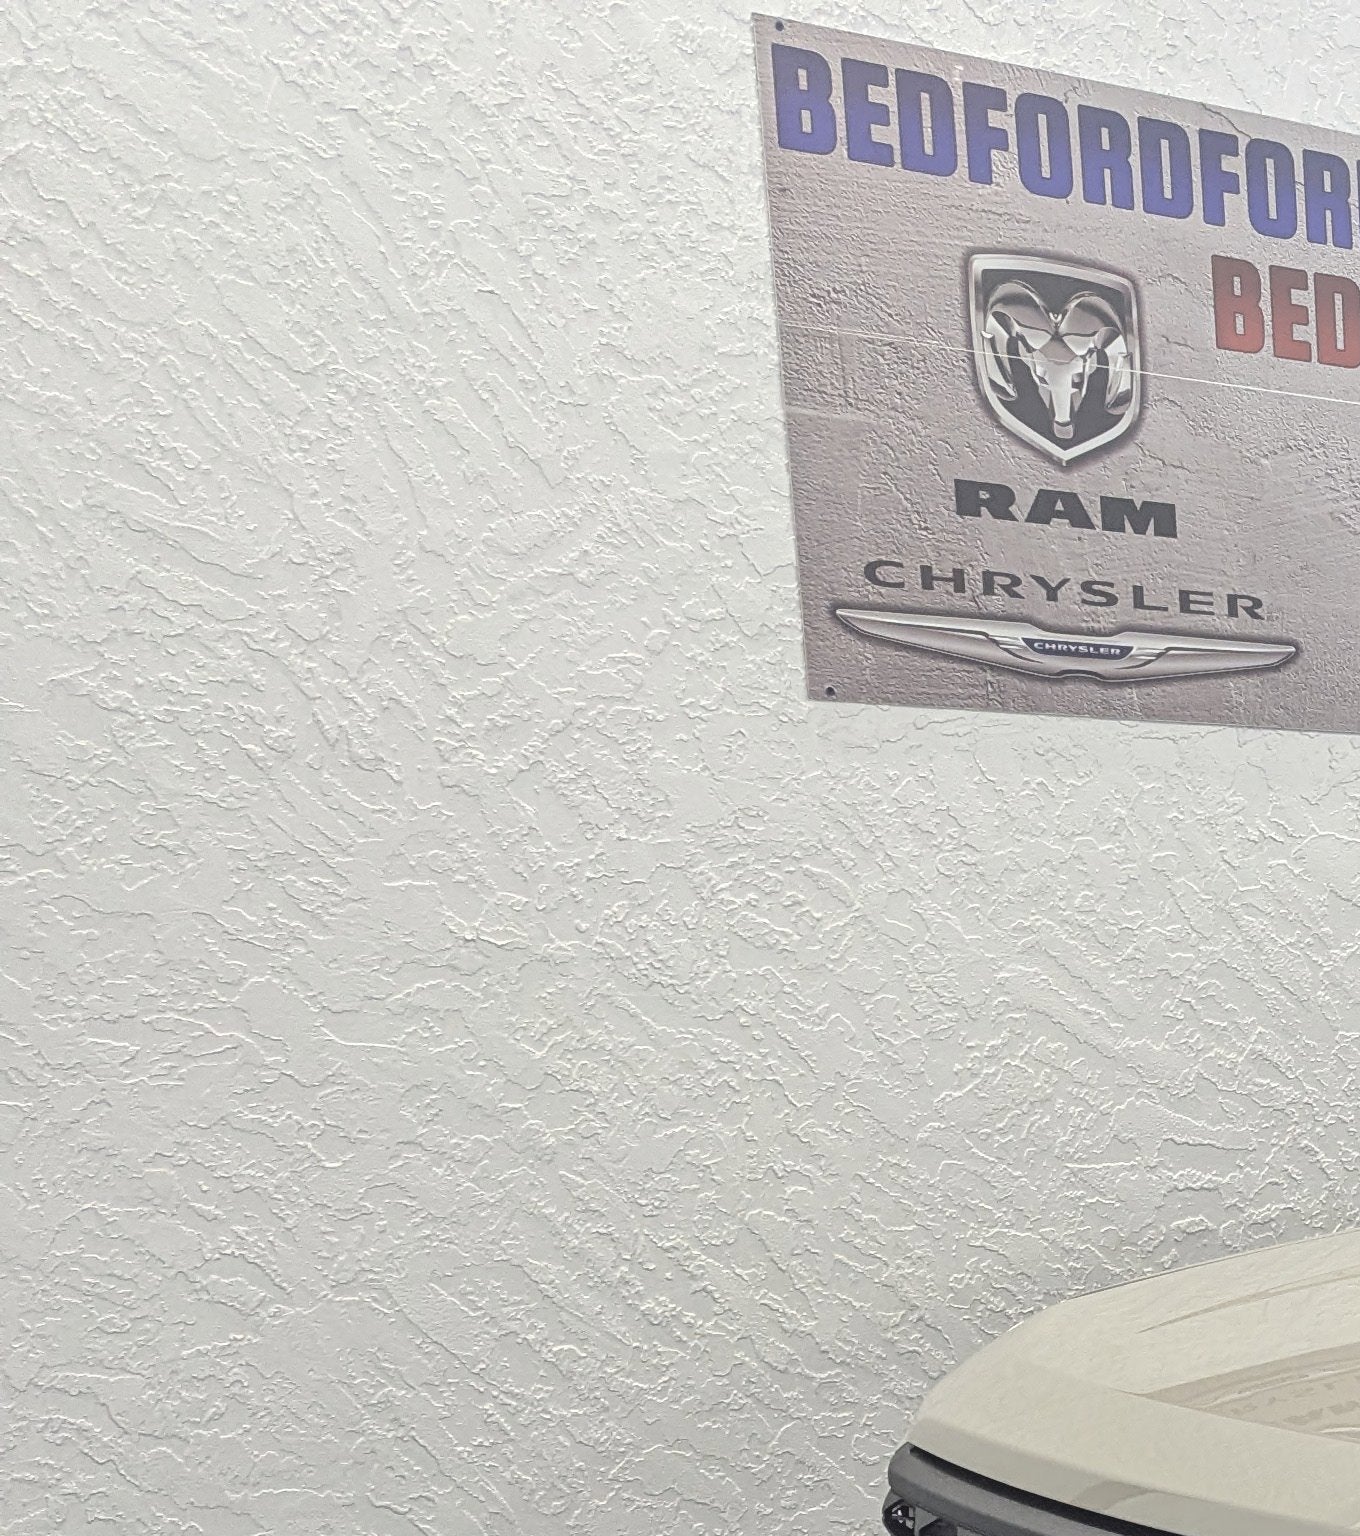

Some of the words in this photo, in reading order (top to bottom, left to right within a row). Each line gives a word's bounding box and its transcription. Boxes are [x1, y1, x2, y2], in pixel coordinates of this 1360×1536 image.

[954, 478, 1178, 539] RAM
[864, 560, 1266, 621] CHRYSLER
[1032, 640, 1123, 657] CHRYSLER
